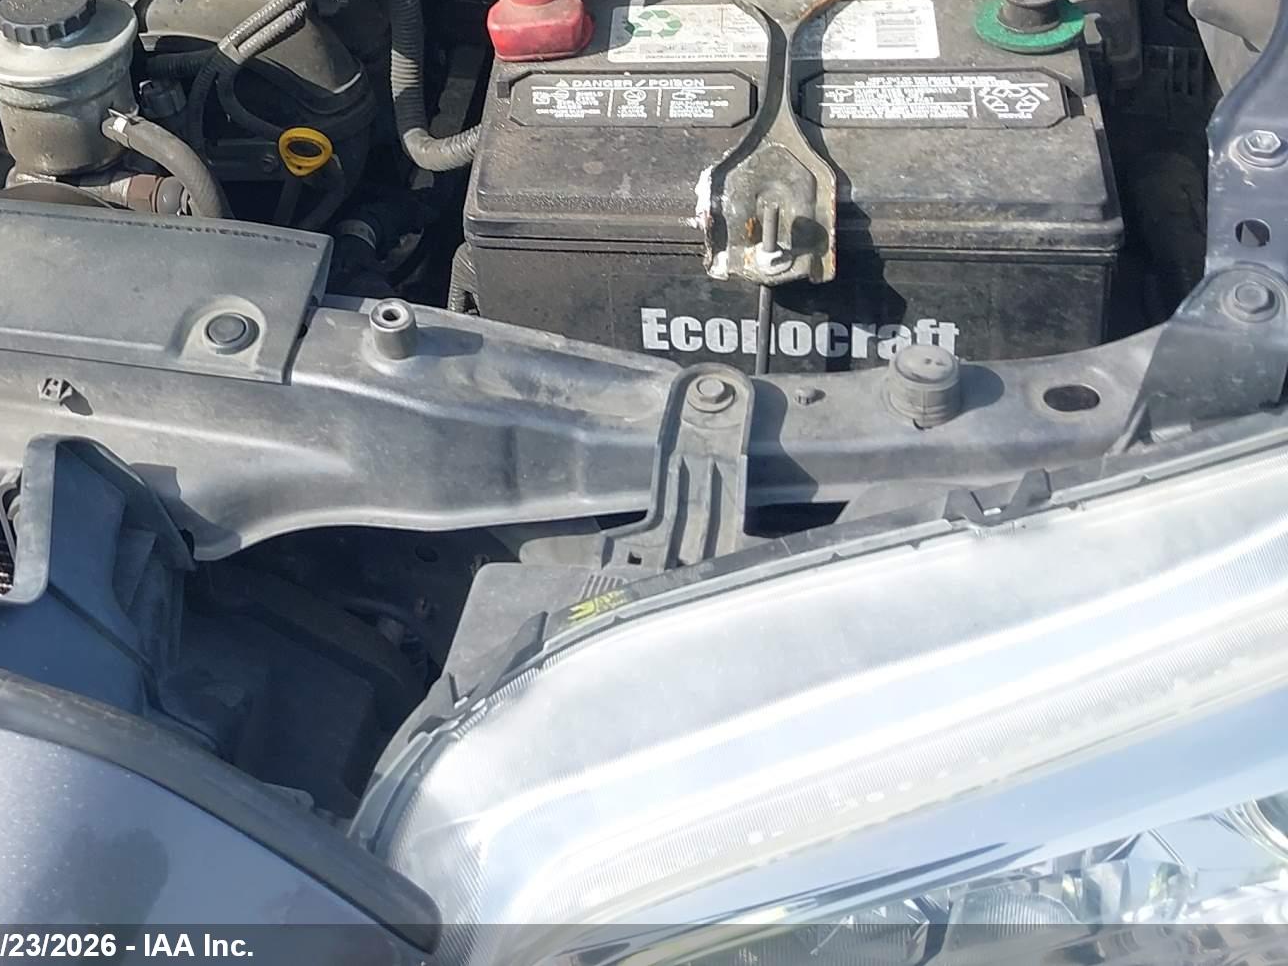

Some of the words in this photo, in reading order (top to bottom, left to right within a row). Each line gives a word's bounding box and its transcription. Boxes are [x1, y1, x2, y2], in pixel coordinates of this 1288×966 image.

[571, 79, 633, 88] DANGER
[648, 78, 705, 87] POISON
[640, 307, 960, 360] Econocraft
